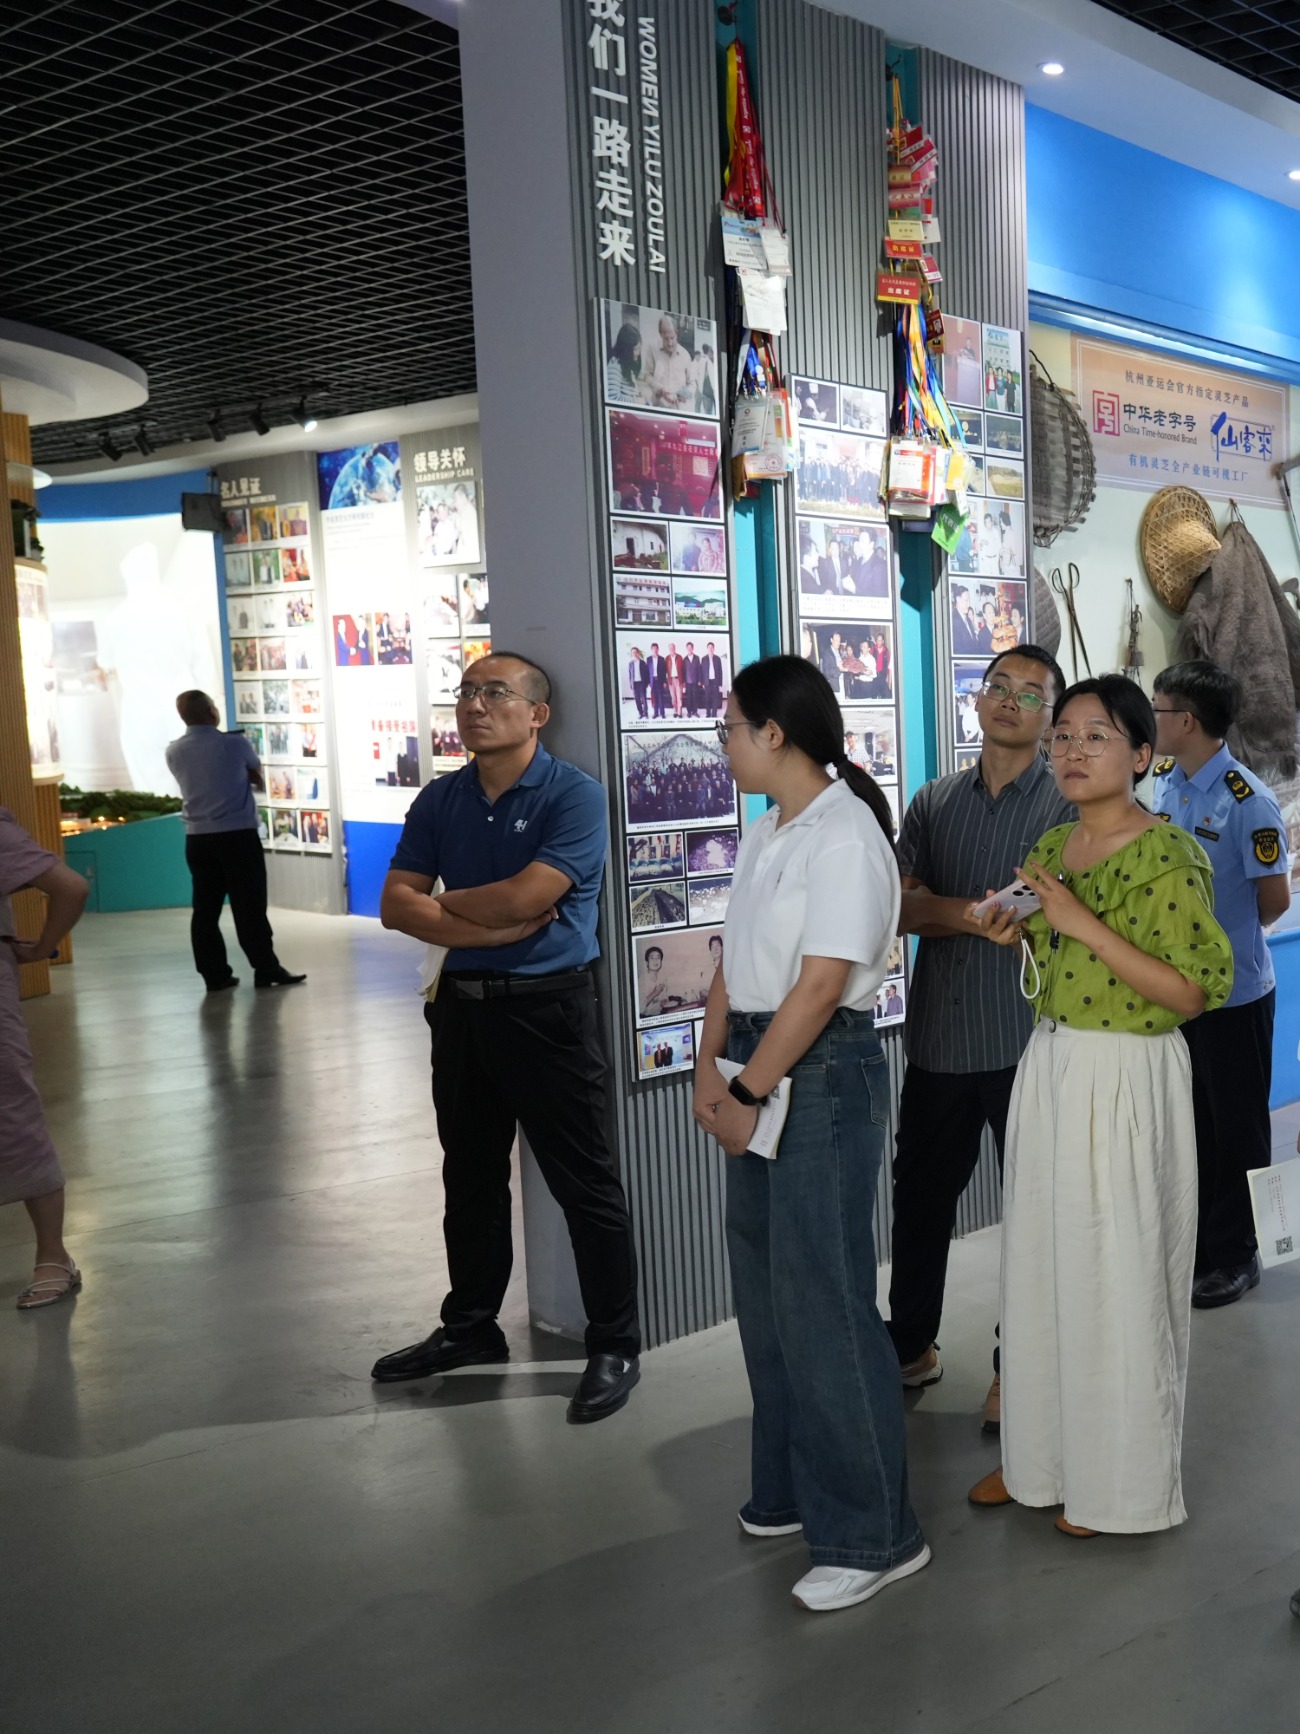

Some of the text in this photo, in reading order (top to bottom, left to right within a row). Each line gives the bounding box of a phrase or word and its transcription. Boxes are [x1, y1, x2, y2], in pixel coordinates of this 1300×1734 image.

[587, 0, 636, 266] 我们一路走来
[638, 17, 666, 273] WOMEN YILU ZOULAI
[1125, 370, 1249, 408] 杭州亚运会官方指定灵芝产品
[1123, 403, 1197, 432] 中华老字号
[1123, 424, 1197, 445] China Time-honored Brand
[414, 447, 466, 473] 领导关怀
[457, 468, 474, 477] CARE
[1128, 453, 1249, 482] 有机灵芝全产业链可视工厂
